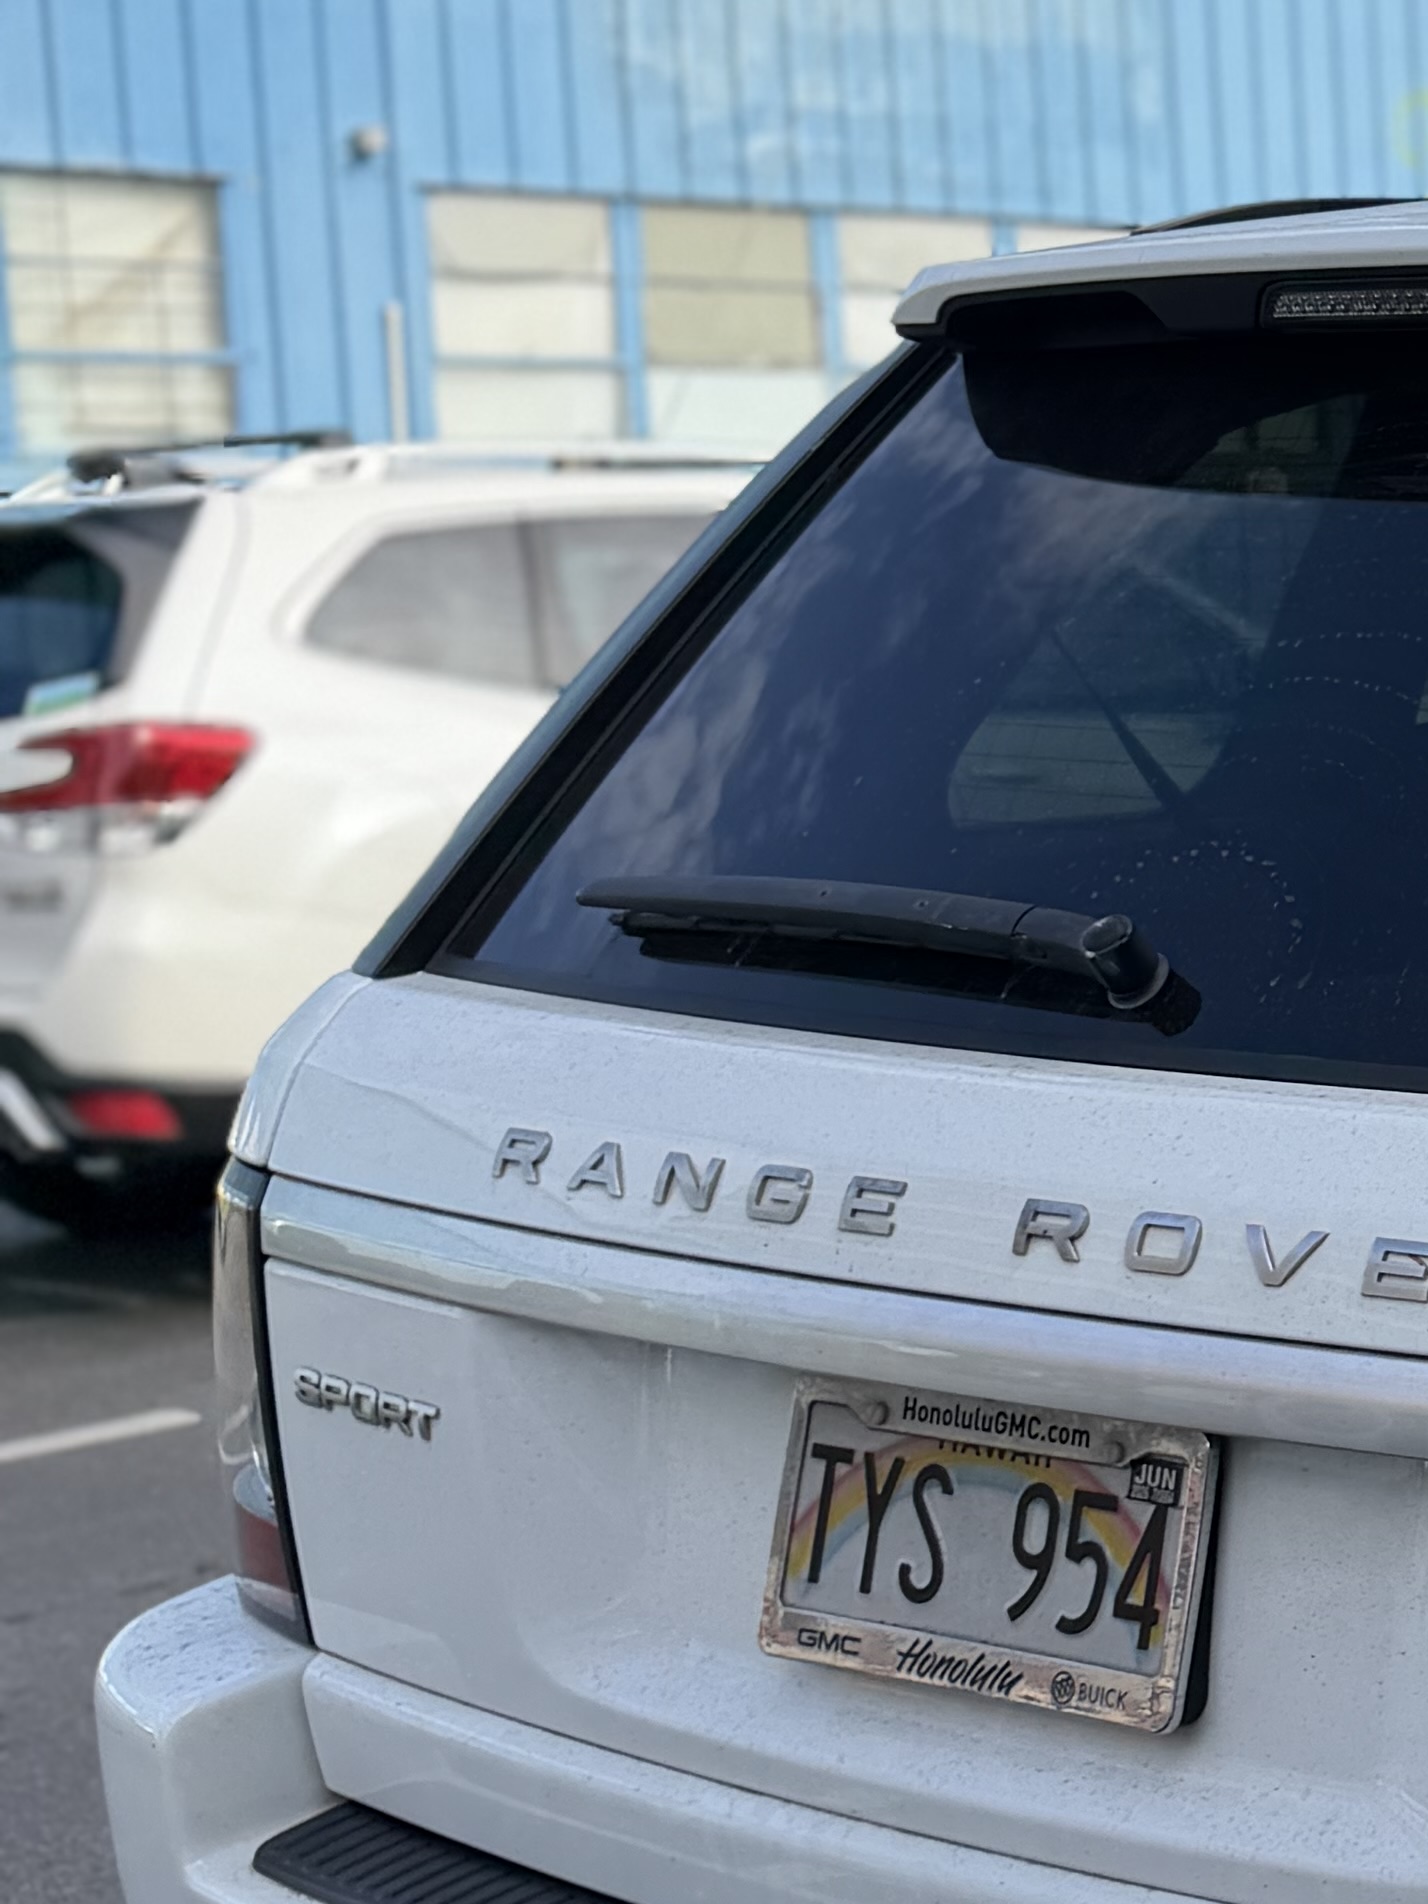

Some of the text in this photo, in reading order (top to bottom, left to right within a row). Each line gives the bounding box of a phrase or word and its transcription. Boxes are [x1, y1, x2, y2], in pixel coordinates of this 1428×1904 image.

[492, 1127, 909, 1238] RANGE
[294, 1366, 441, 1443] SPORT
[902, 1396, 1091, 1449] HonoluluGMC.com
[1134, 1463, 1177, 1491] JUN
[806, 1443, 1168, 1651] TYS 954
[797, 1627, 862, 1657] GMC
[896, 1637, 1025, 1697] Honolulu
[1077, 1682, 1129, 1711] BUICK
